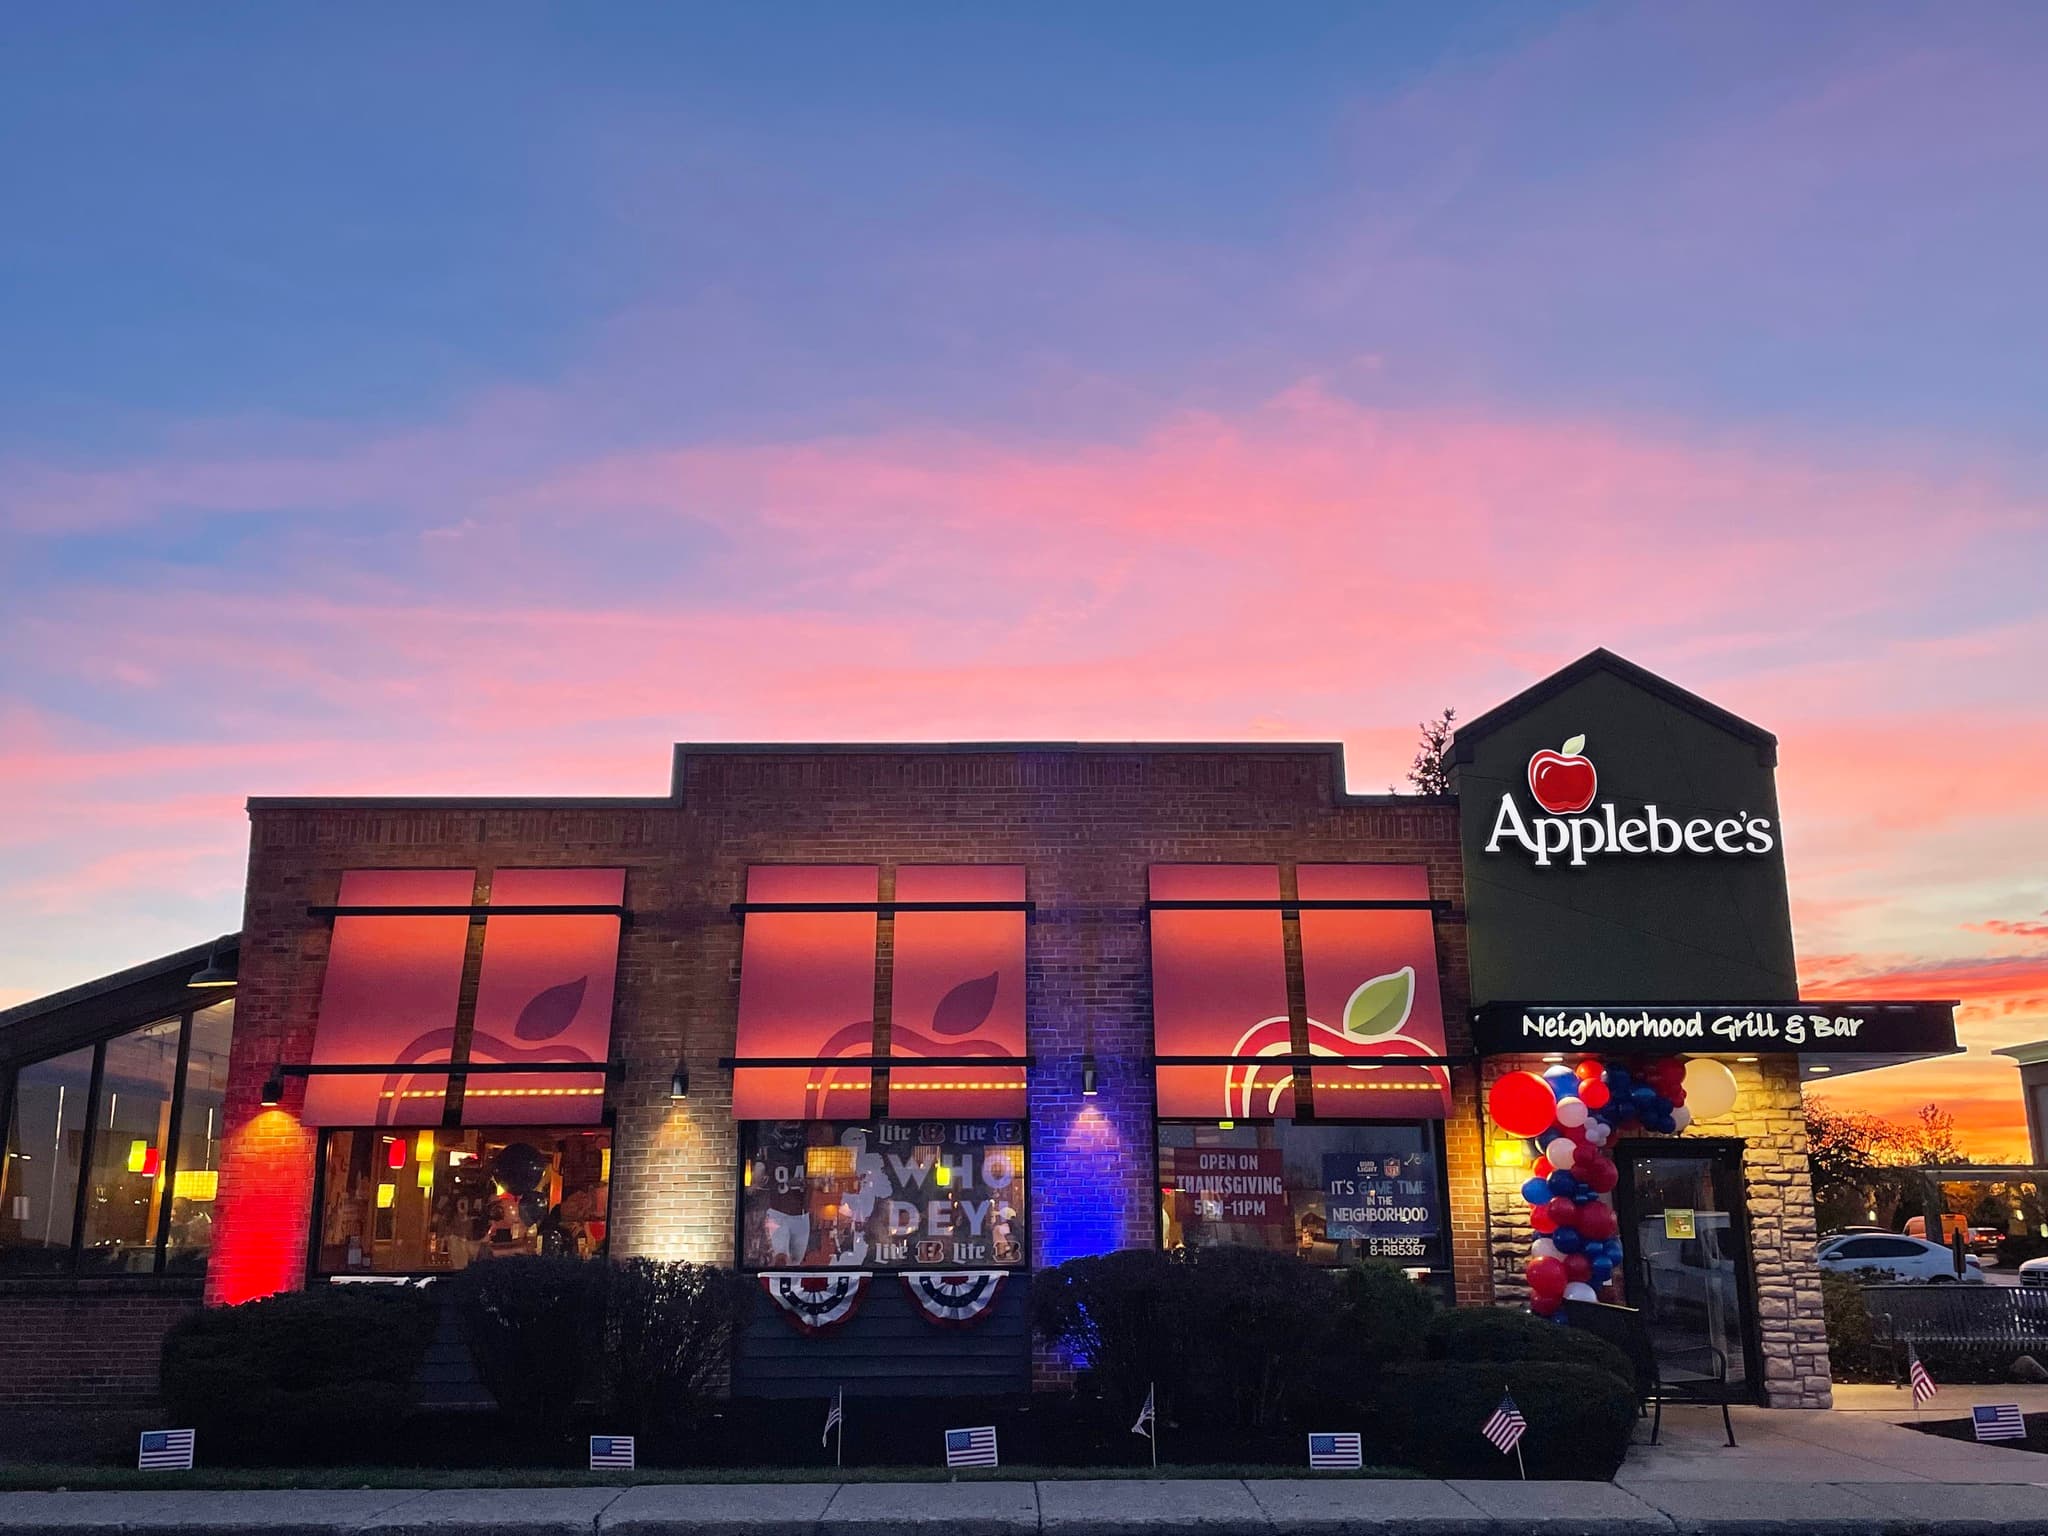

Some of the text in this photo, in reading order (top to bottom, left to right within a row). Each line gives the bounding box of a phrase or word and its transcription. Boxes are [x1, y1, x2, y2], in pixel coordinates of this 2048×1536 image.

[1485, 793, 1774, 866] Applebee's
[1522, 1011, 1864, 1046] Neighborhood Grill & Bar
[879, 1124, 911, 1144] Lite
[954, 1124, 986, 1144] Lite
[886, 1153, 1014, 1189] WHO
[1200, 1153, 1259, 1170] OPEN ON
[775, 1165, 805, 1194] 94
[1176, 1175, 1282, 1195] THANKSGIVING
[1331, 1180, 1426, 1195] IT'S GAME TIME
[1367, 1196, 1393, 1206] IN THE
[888, 1200, 991, 1236] DEY
[1333, 1206, 1429, 1222] NEIGHBORHOOD
[875, 1242, 909, 1264] Lite
[952, 1242, 986, 1264] Lite
[1370, 1244, 1426, 1256] 8-RB5367
